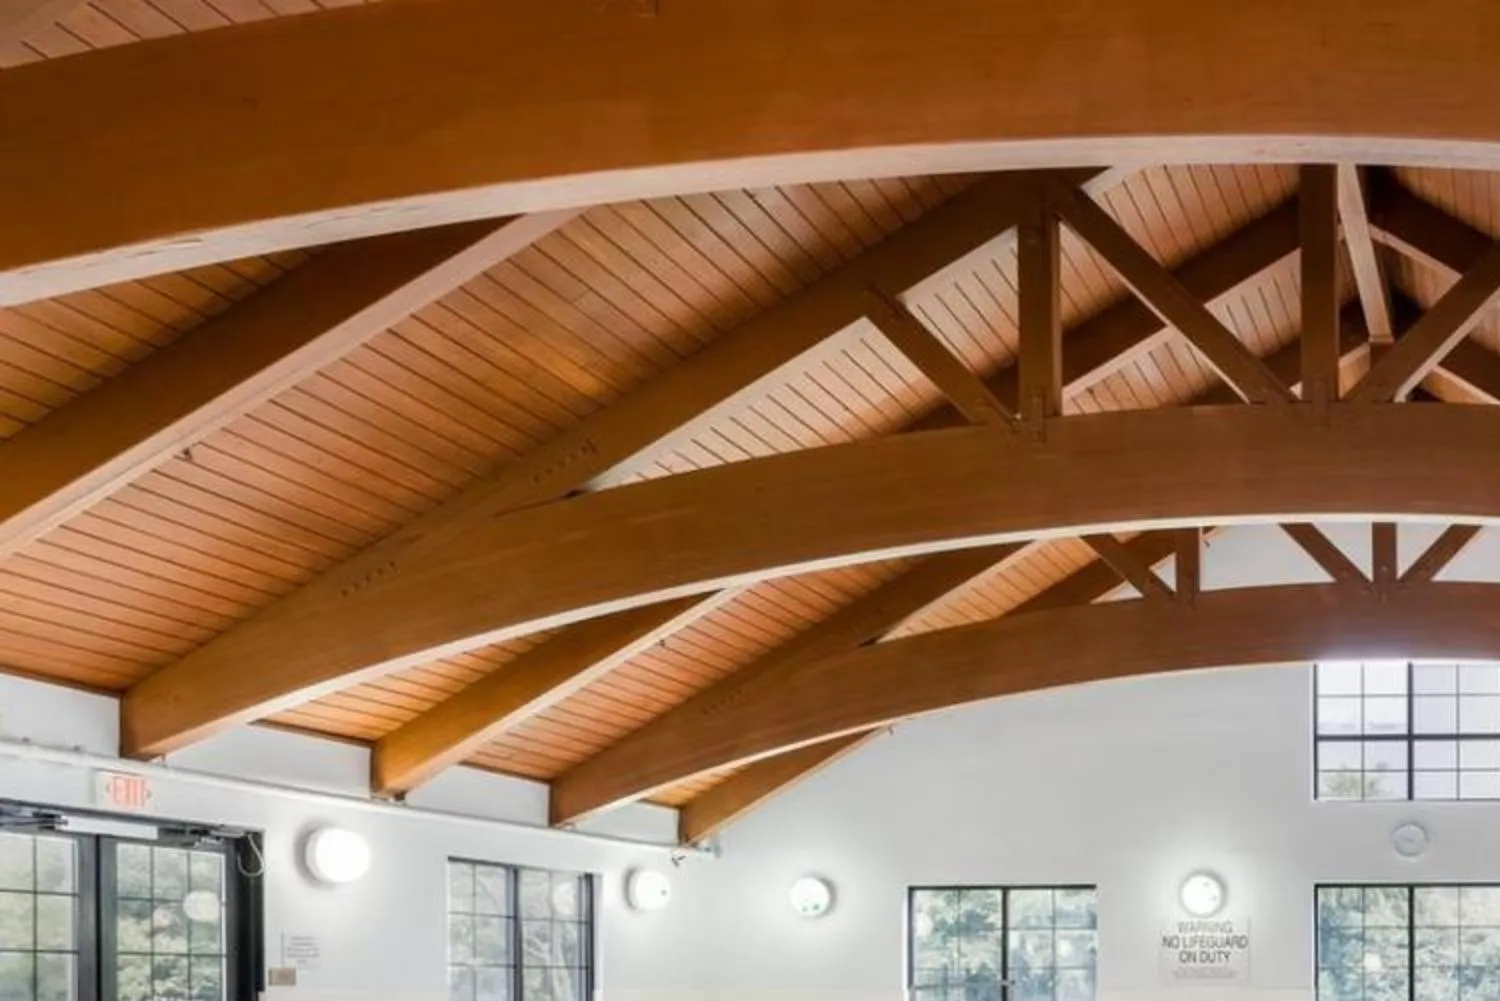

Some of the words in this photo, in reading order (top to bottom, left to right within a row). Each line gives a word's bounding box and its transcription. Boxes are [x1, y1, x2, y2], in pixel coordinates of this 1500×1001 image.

[112, 775, 146, 808] EXIT
[1162, 935, 1180, 949] NO
[1182, 935, 1249, 949] LIFEGUARD
[1179, 950, 1197, 963] ON
[1199, 950, 1232, 963] DUTY
